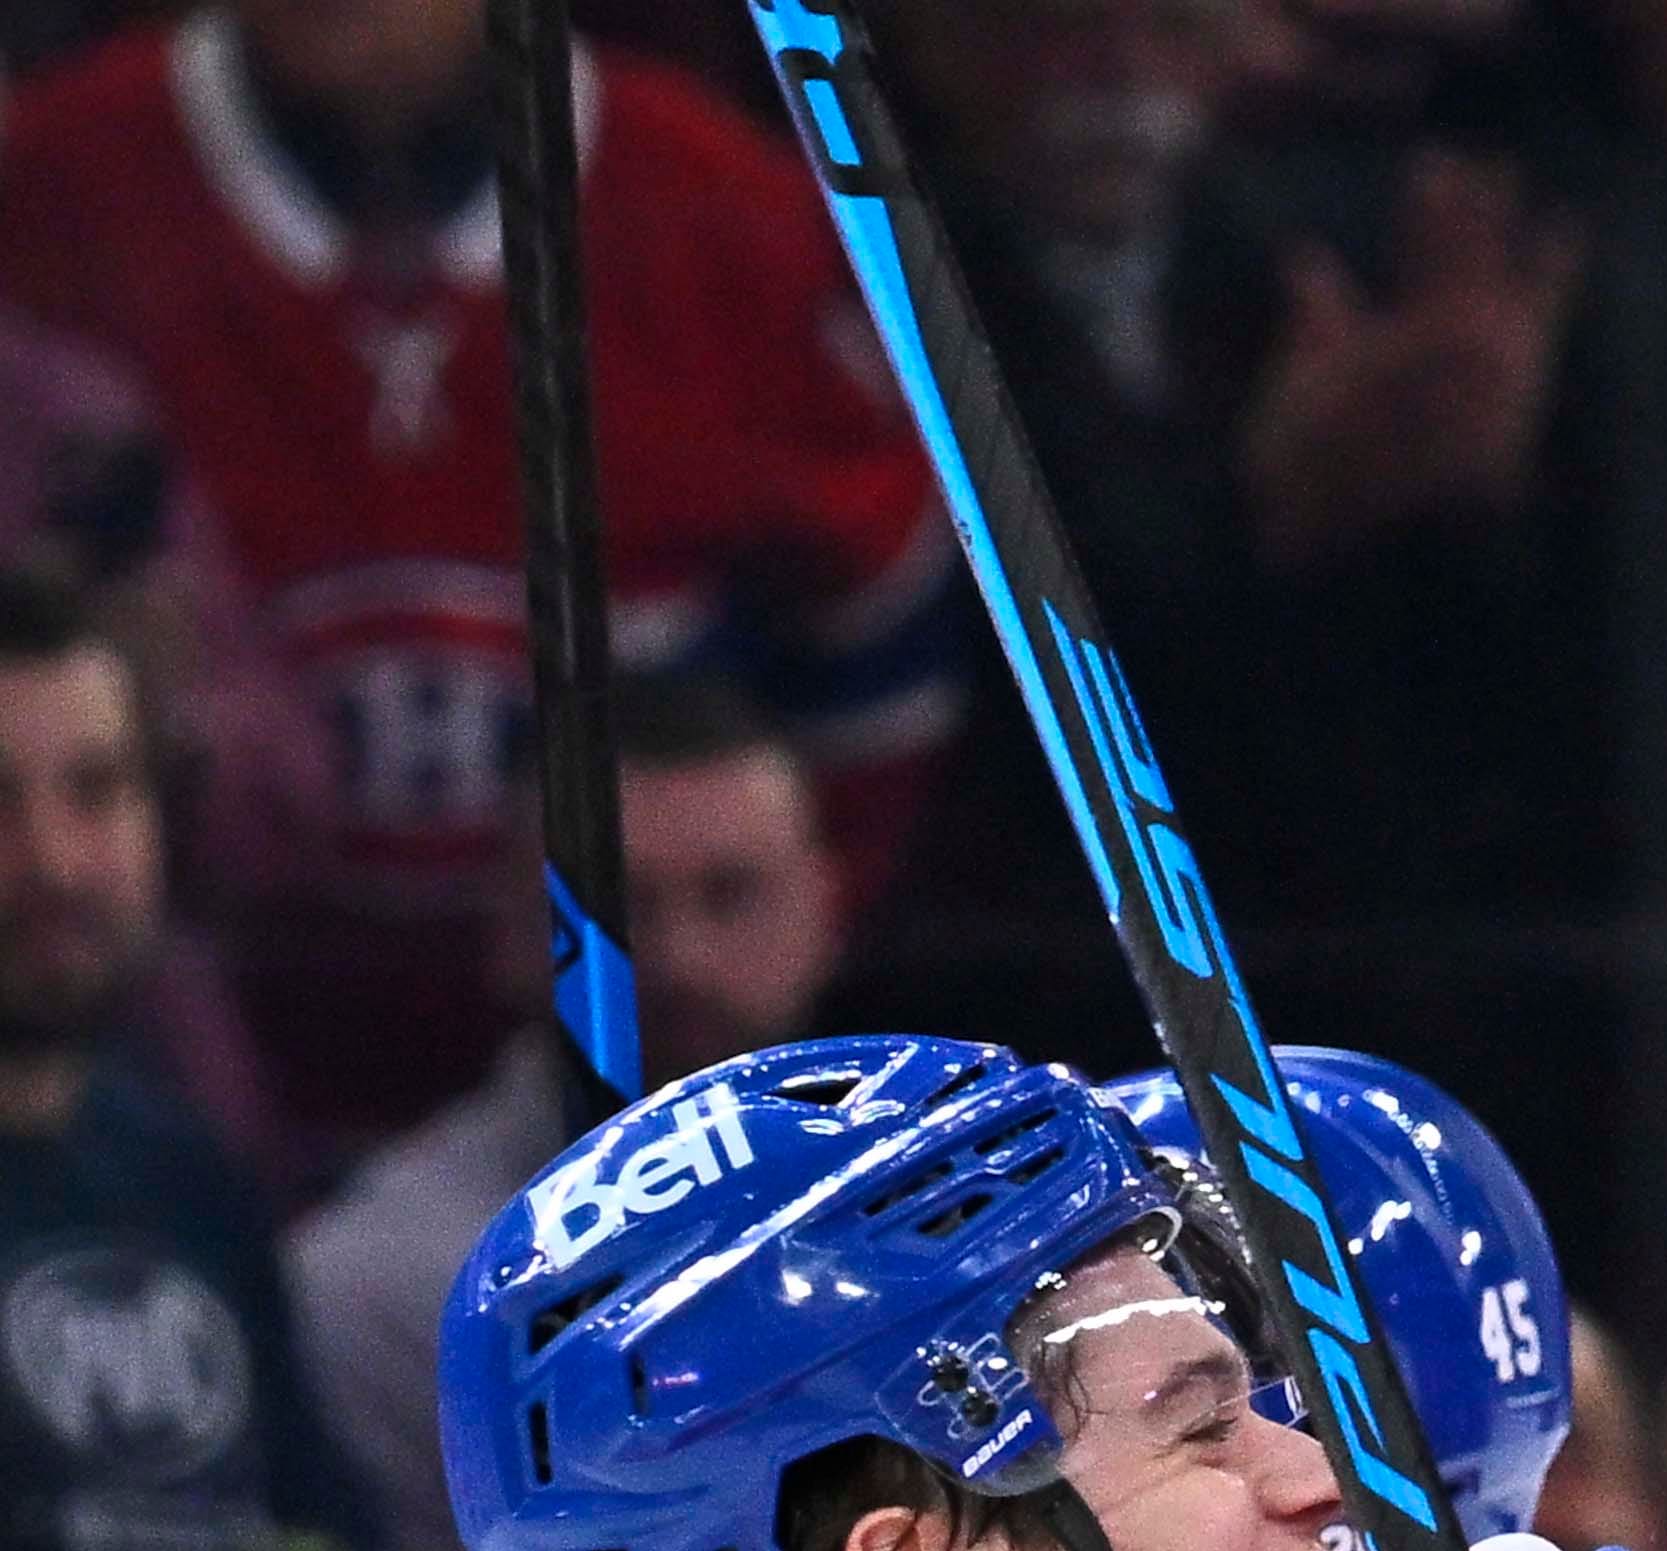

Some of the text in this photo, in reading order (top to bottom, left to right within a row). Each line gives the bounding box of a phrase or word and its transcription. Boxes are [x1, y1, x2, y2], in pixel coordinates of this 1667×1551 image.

[1041, 598, 1437, 1532] PULSE
[527, 1085, 754, 1266] Bell
[1480, 1277, 1541, 1381] 45
[962, 1410, 1033, 1478] BAUER
